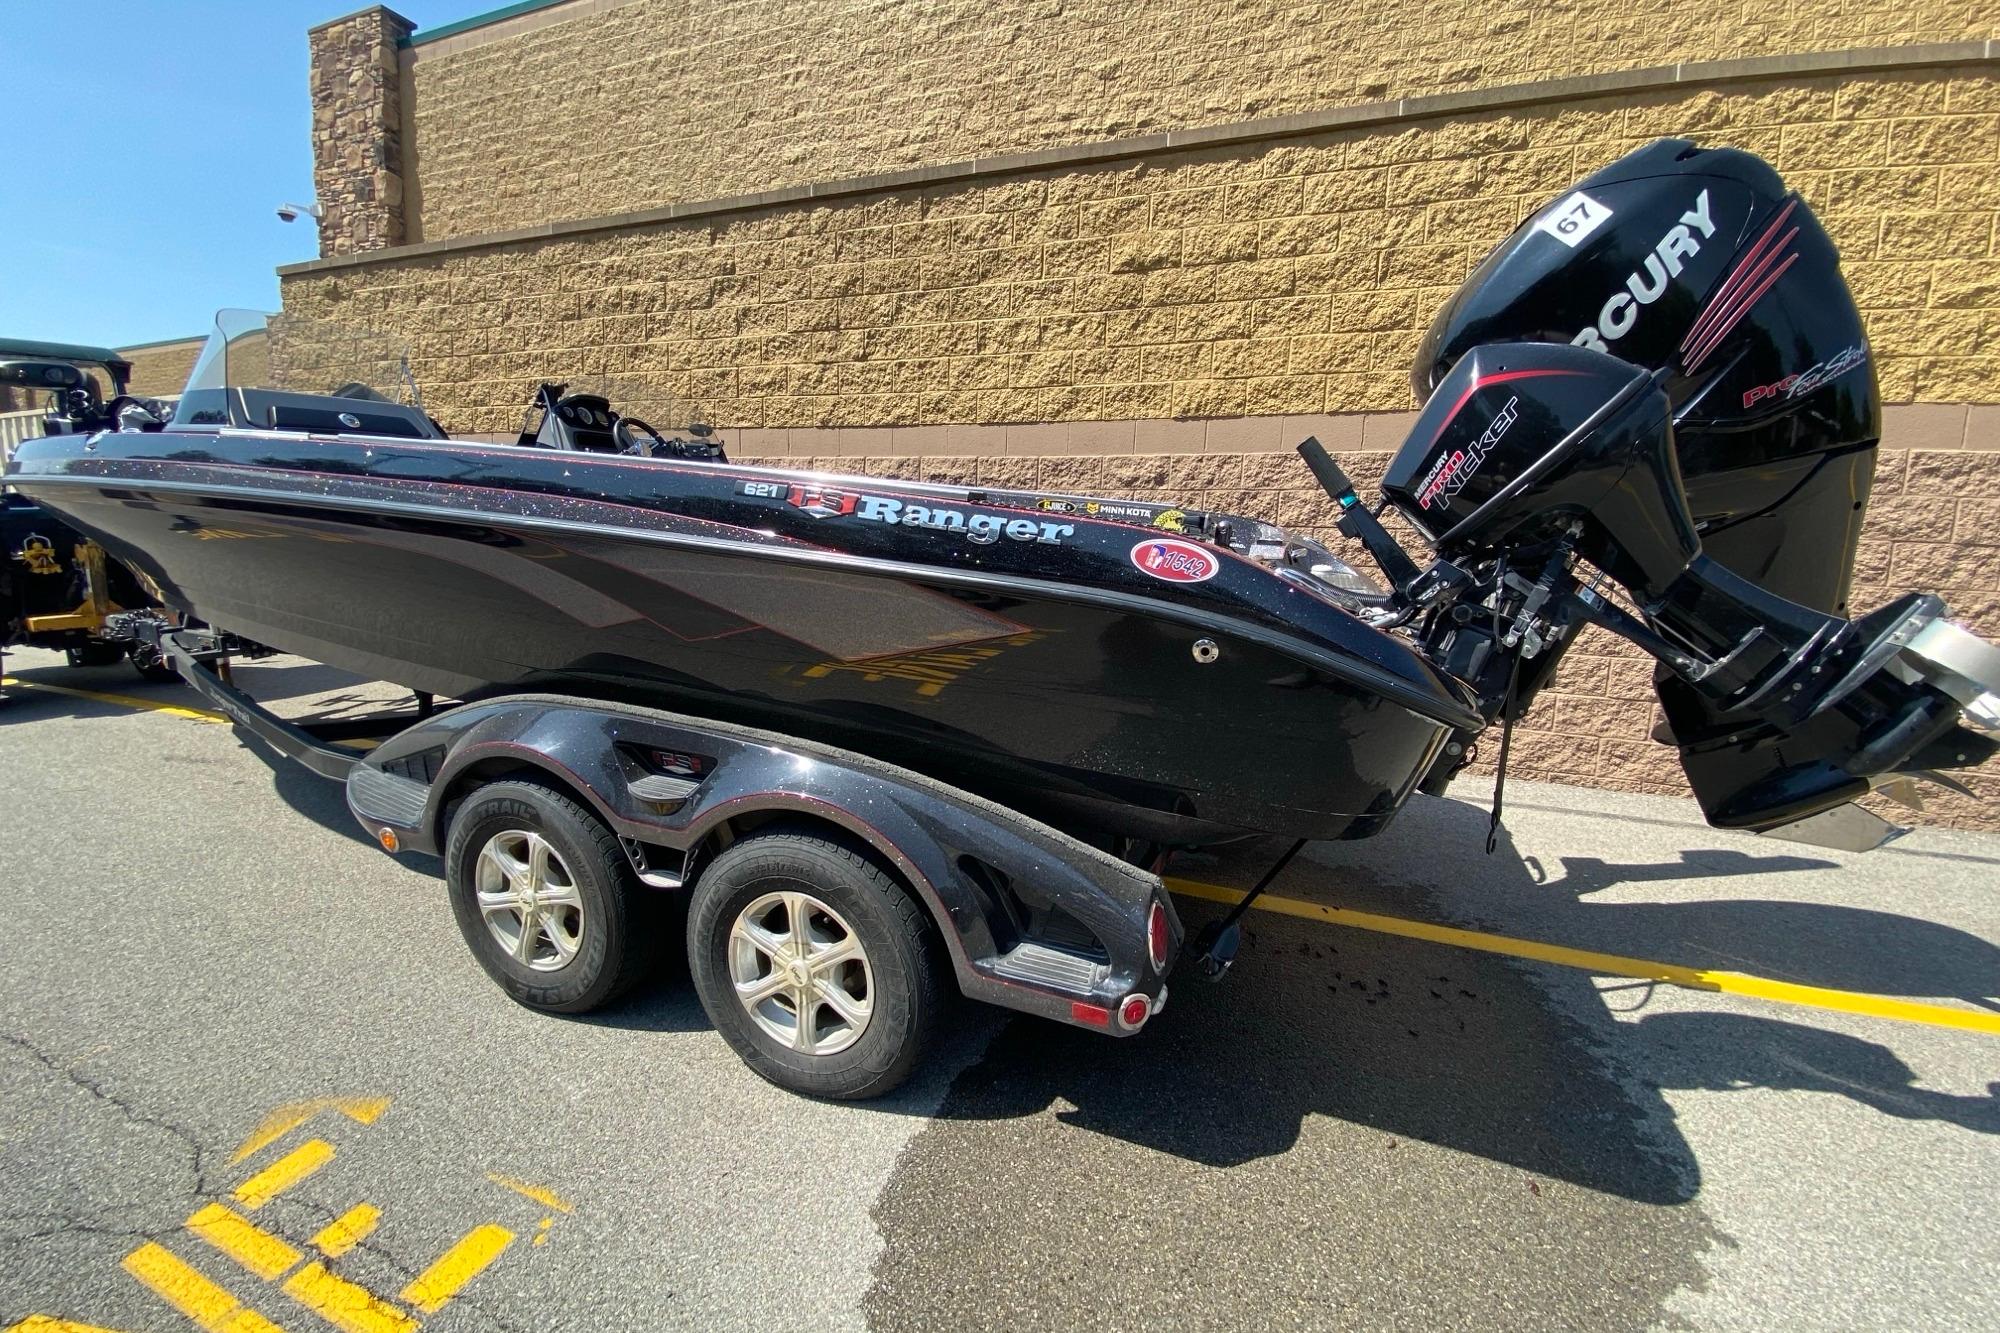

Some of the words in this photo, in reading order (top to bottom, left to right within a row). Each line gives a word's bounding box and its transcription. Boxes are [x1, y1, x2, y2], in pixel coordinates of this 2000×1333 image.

[1556, 202, 1592, 235] 67
[1743, 374, 1800, 409] Pro
[1413, 450, 1449, 500] MERCURY
[1420, 450, 1465, 510] PRO
[744, 483, 779, 497] 621
[857, 495, 1074, 545] Ranger
[1100, 505, 1126, 515] MINN
[1126, 507, 1152, 517] KOTA
[1164, 551, 1206, 578] 1542
